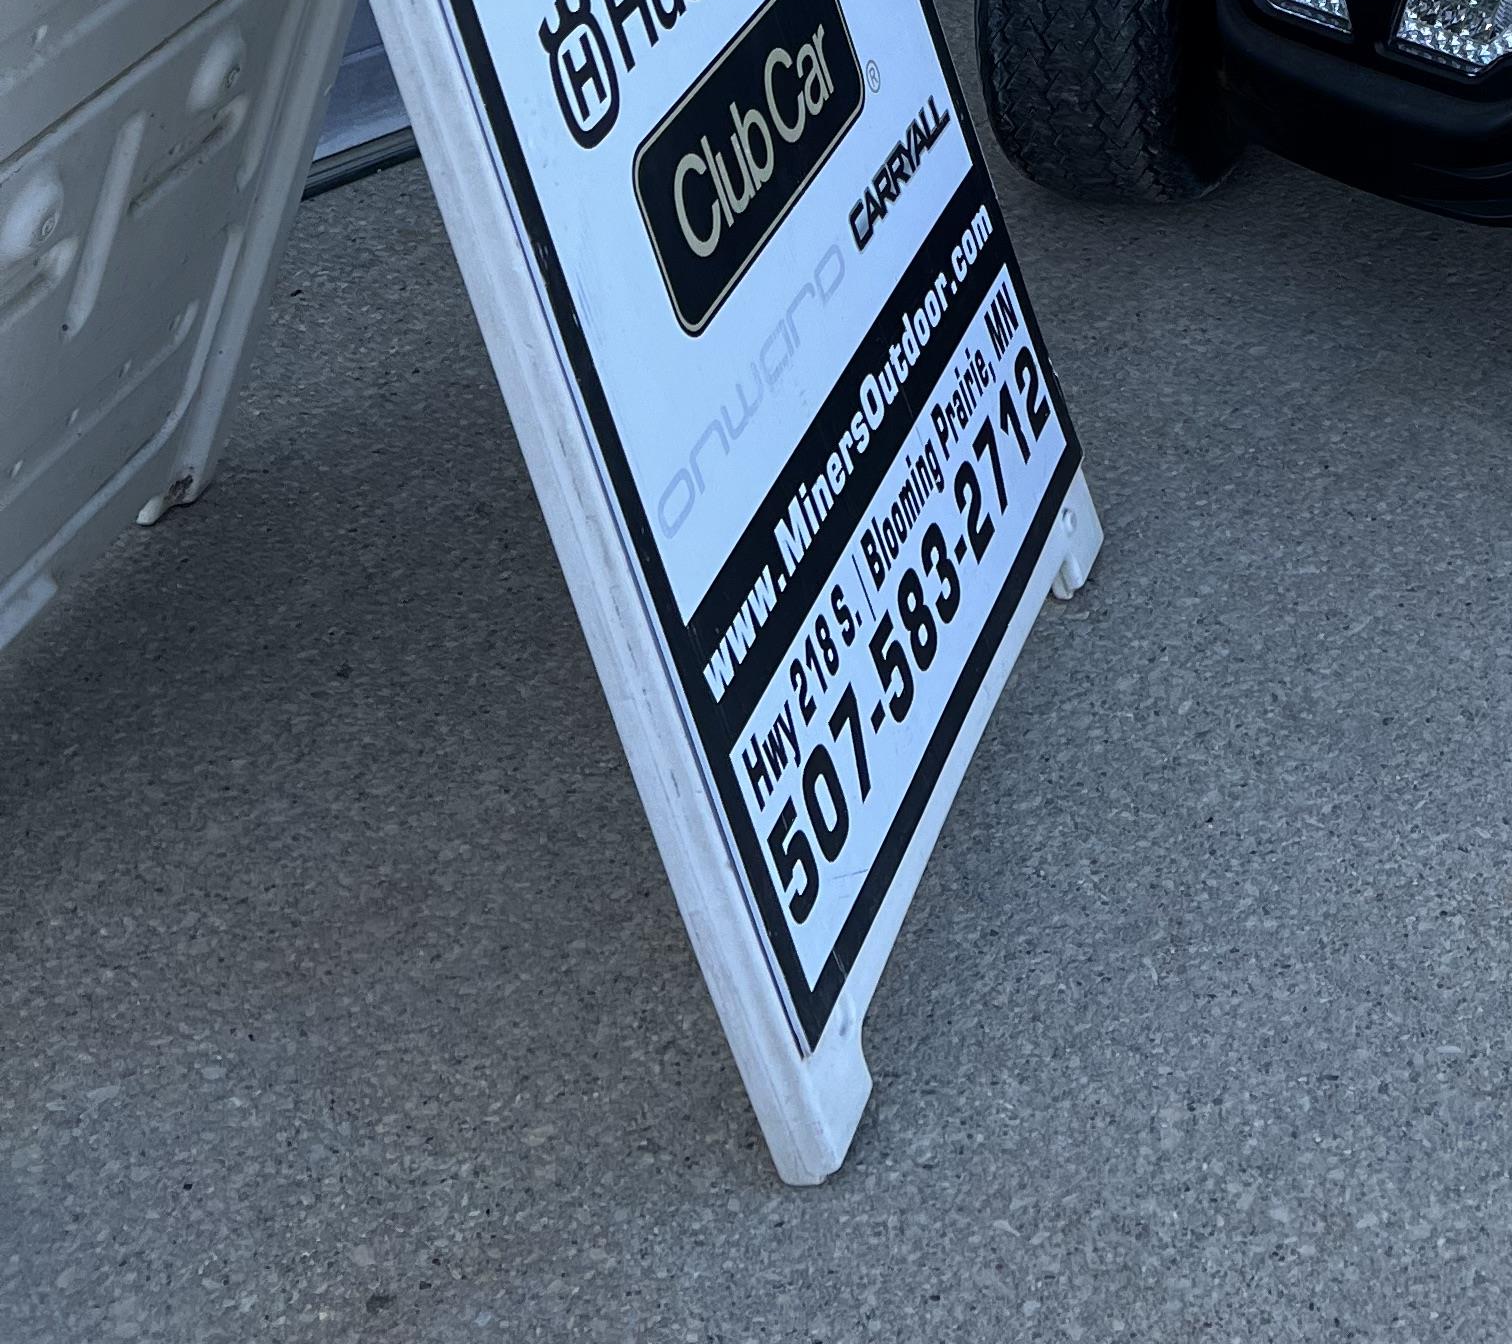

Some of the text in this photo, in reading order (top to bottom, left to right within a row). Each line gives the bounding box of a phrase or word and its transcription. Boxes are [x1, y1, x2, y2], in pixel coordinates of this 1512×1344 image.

[848, 95, 951, 253] CARRYALL
[703, 204, 994, 704] www.MinersOutdoor.com
[741, 280, 1019, 812] Hwy 218 S. Blooming Prairie, MN
[766, 345, 1051, 925] 507-583-2712
